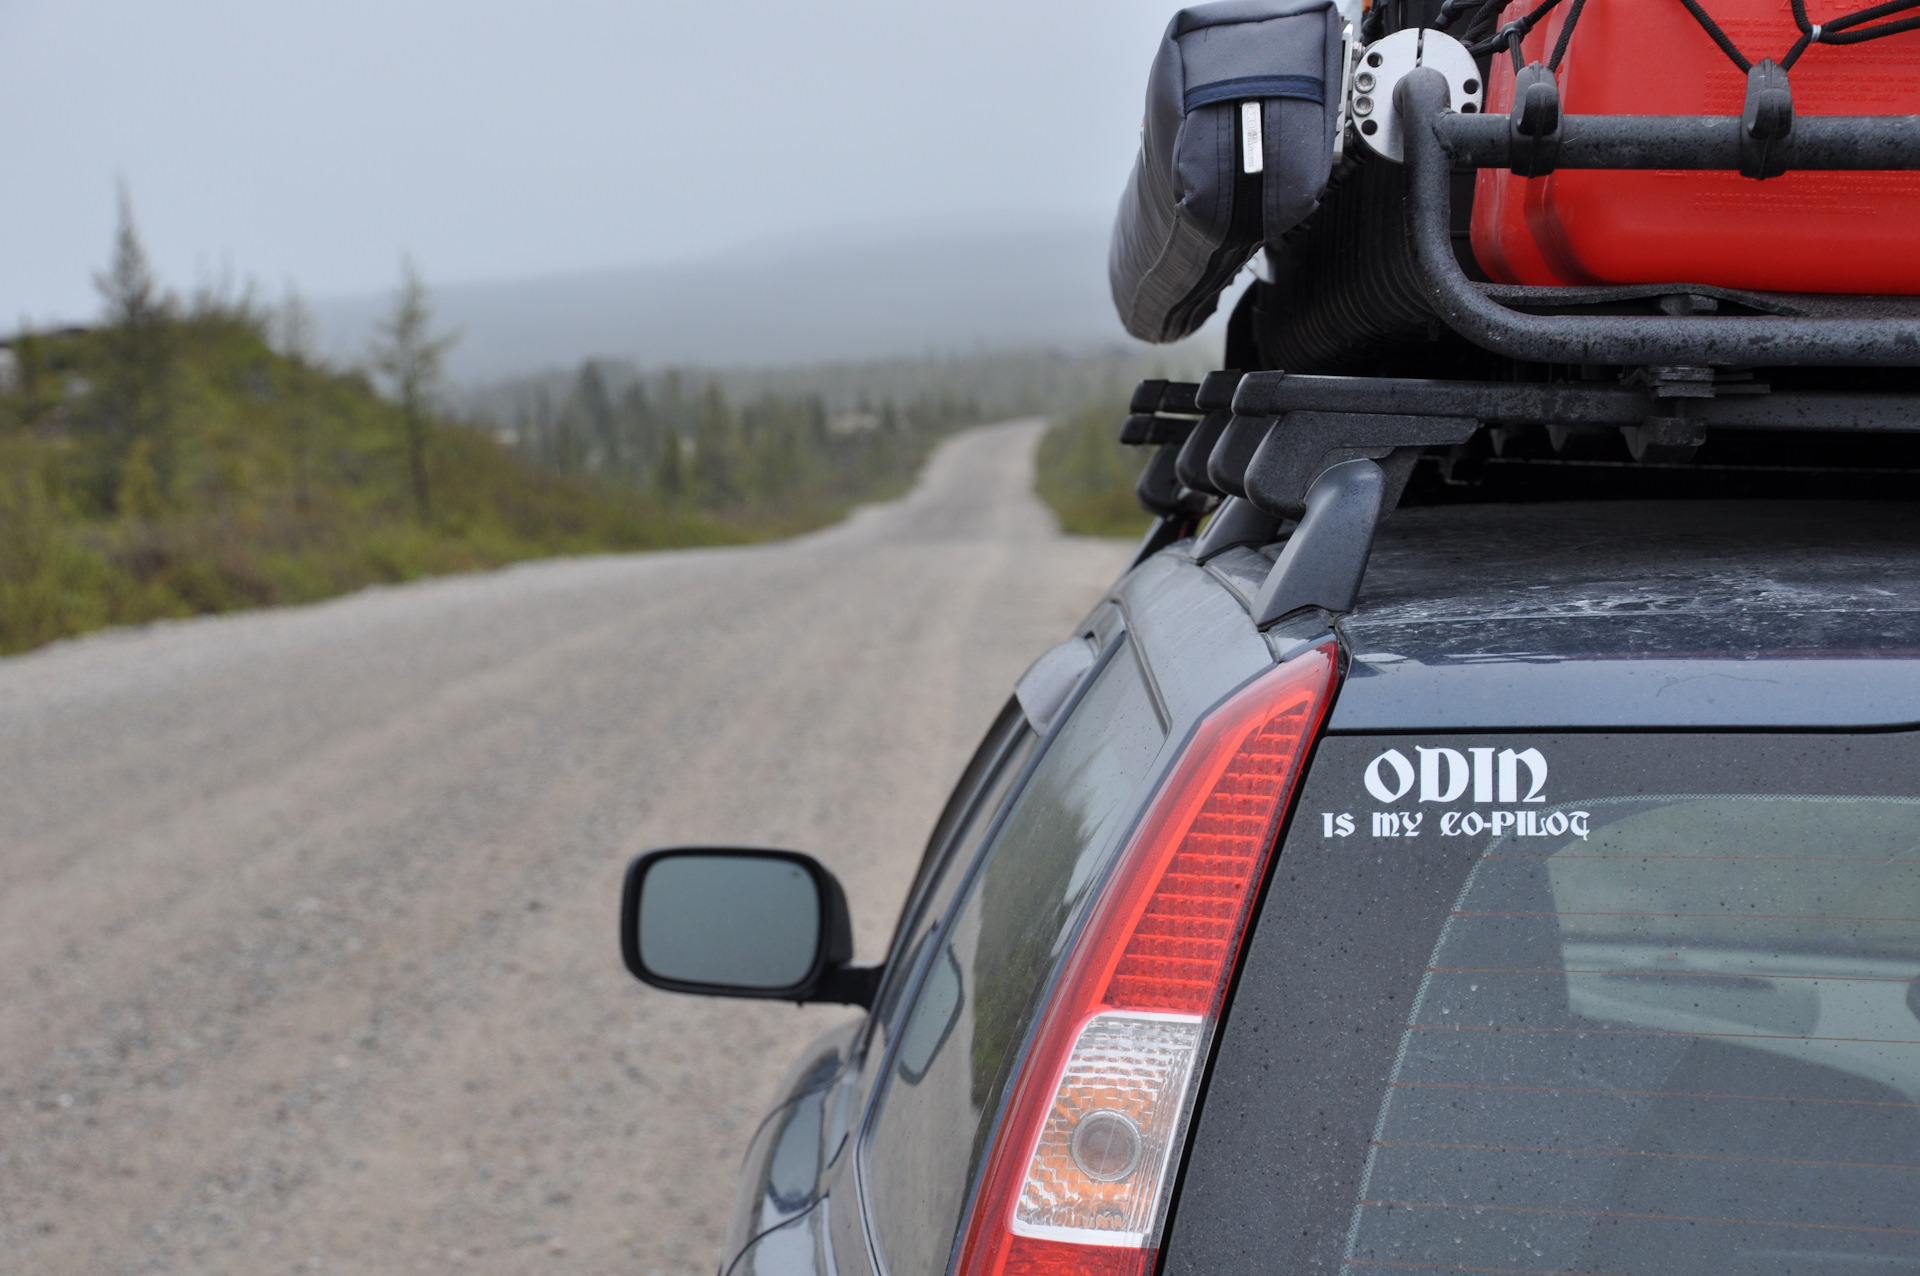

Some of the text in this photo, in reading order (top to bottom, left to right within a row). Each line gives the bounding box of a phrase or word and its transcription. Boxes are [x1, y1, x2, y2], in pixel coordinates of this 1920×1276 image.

[1363, 745, 1548, 804] ODIN
[1322, 811, 1591, 841] IS MY CO-PILOT
